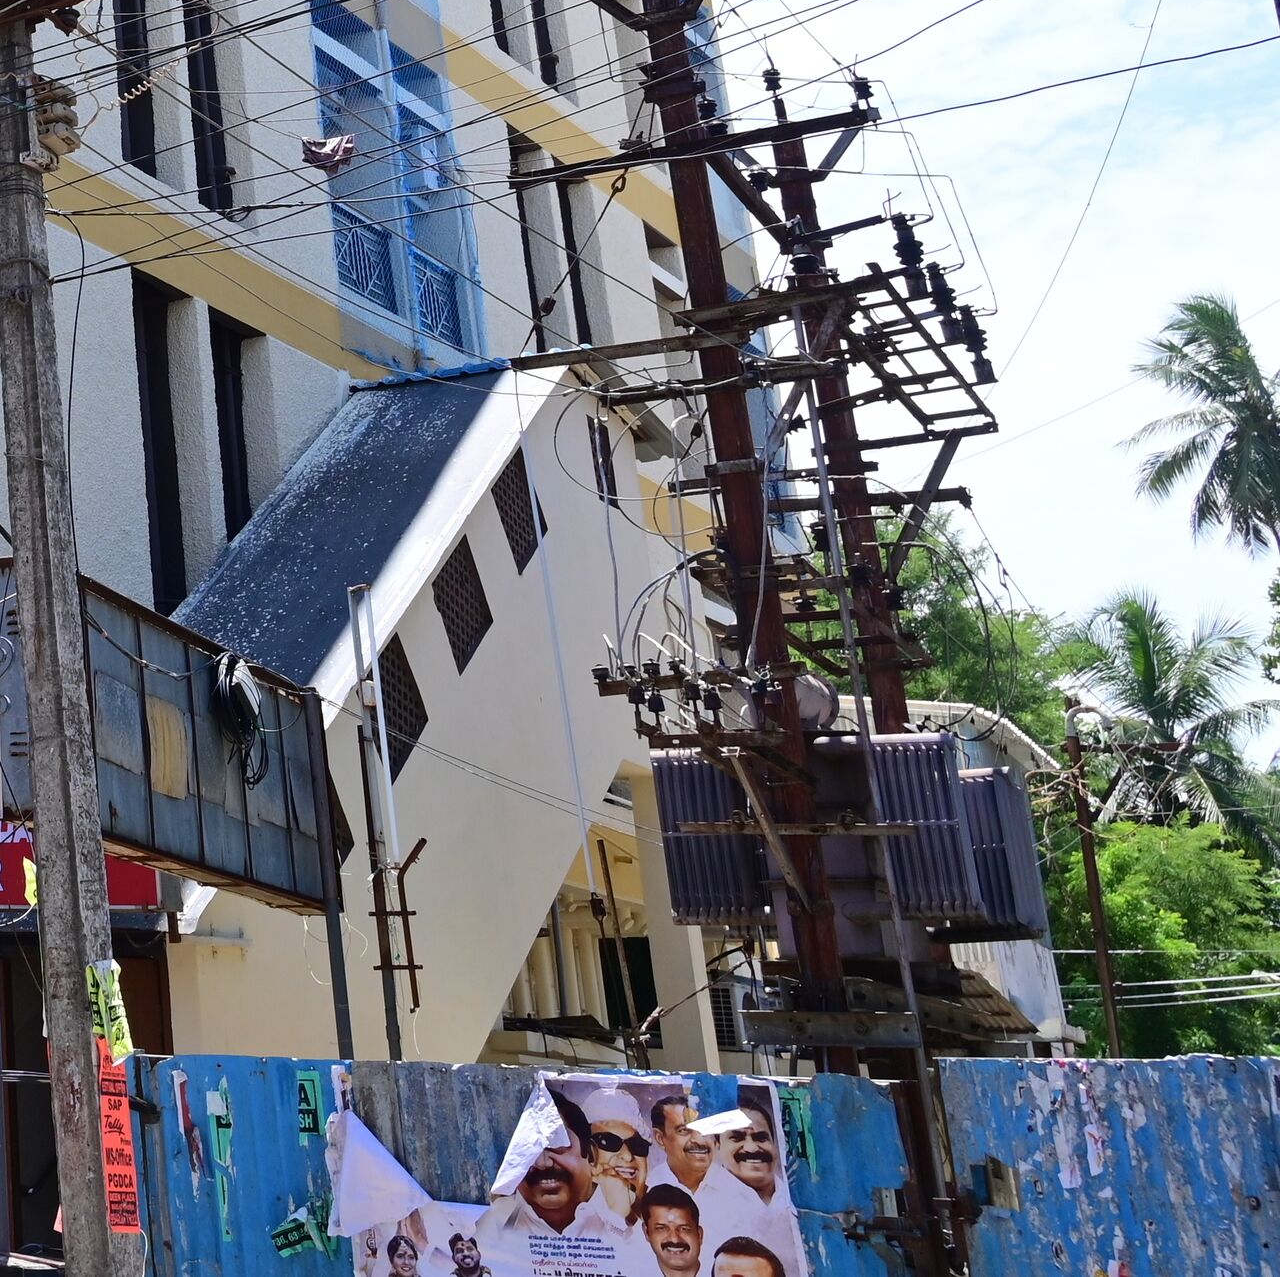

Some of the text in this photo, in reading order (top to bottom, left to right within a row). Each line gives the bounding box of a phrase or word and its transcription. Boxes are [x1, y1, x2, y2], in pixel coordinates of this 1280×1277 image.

[107, 1098, 123, 1111] SAP
[104, 1114, 125, 1133] Tally
[105, 1147, 132, 1166] MS-Office
[108, 1173, 134, 1189] PGDCA
